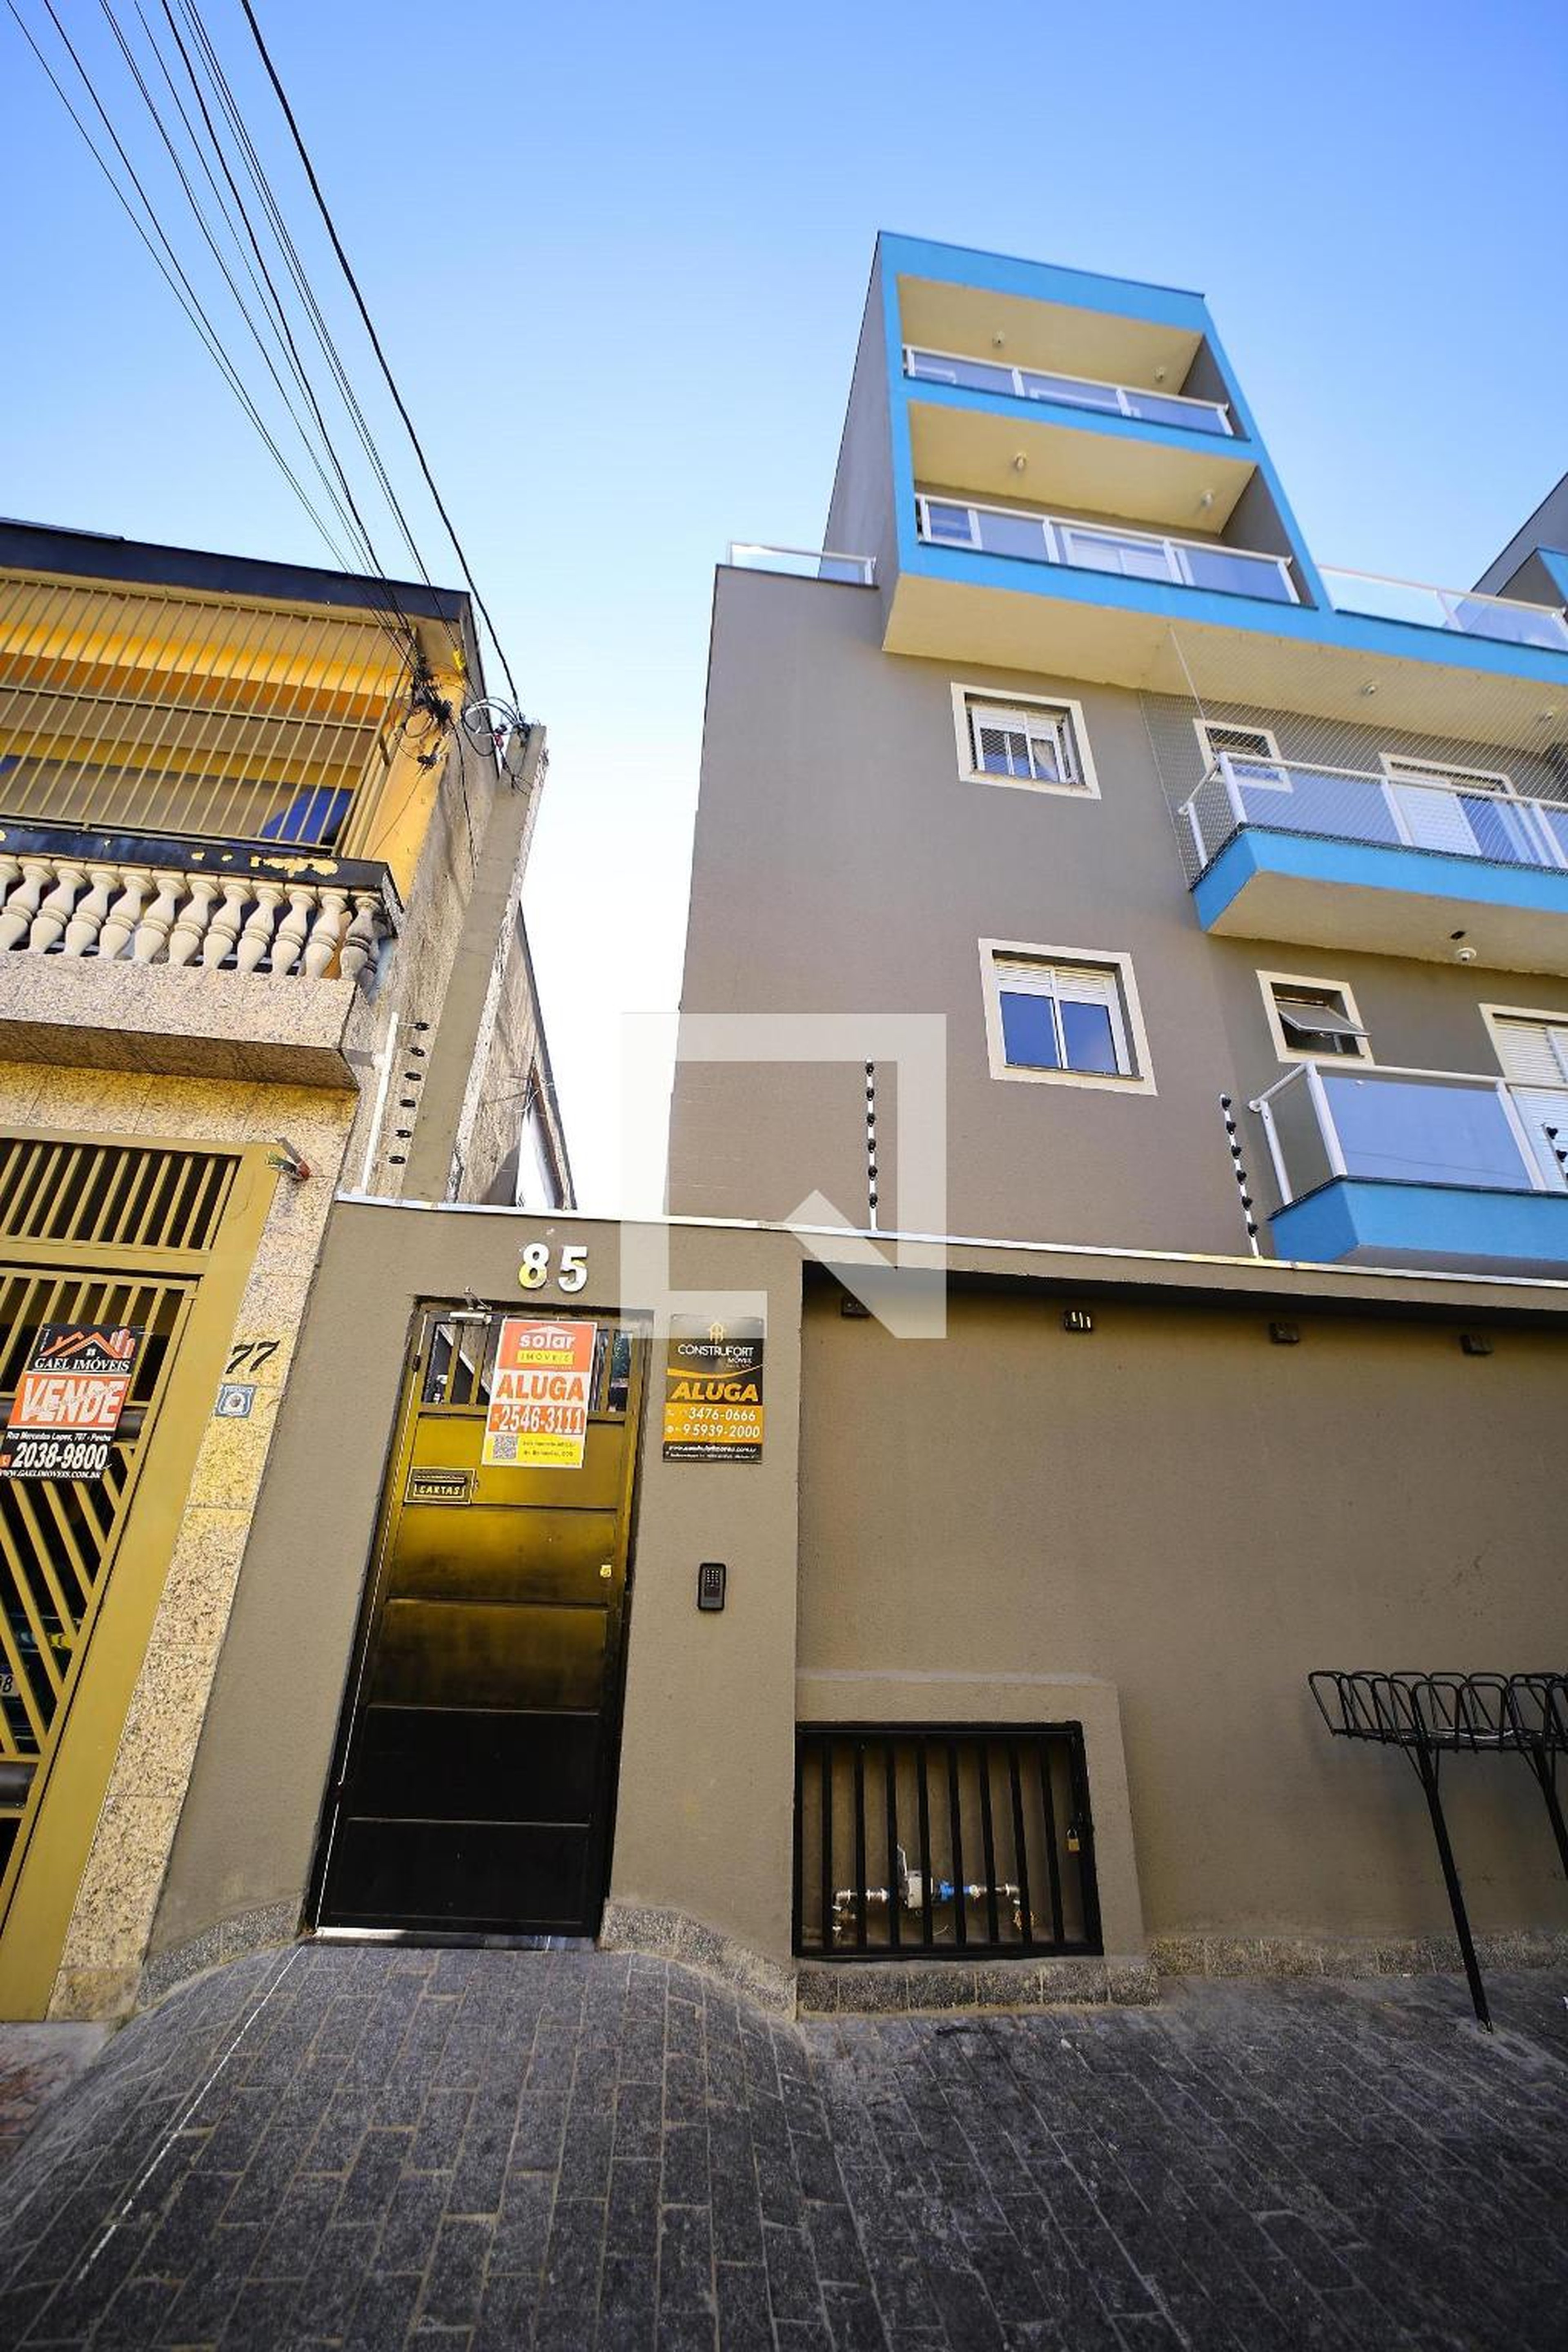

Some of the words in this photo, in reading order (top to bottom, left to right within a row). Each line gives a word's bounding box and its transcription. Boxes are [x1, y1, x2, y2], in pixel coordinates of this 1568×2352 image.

[519, 1243, 588, 1292] 85
[519, 1333, 576, 1349] solar
[678, 1344, 754, 1356] CONSTRUFORT
[34, 1358, 71, 1369] GAEL
[72, 1356, 131, 1371] IMÓVEIS
[225, 1340, 281, 1374] 77
[20, 1378, 126, 1423] VENDE
[496, 1374, 584, 1401] ALUGA
[670, 1382, 759, 1401] ALUGA
[499, 1405, 583, 1433] 2546-3111
[688, 1407, 756, 1421] 3476-0666
[11, 1442, 108, 1469] 2038-9800
